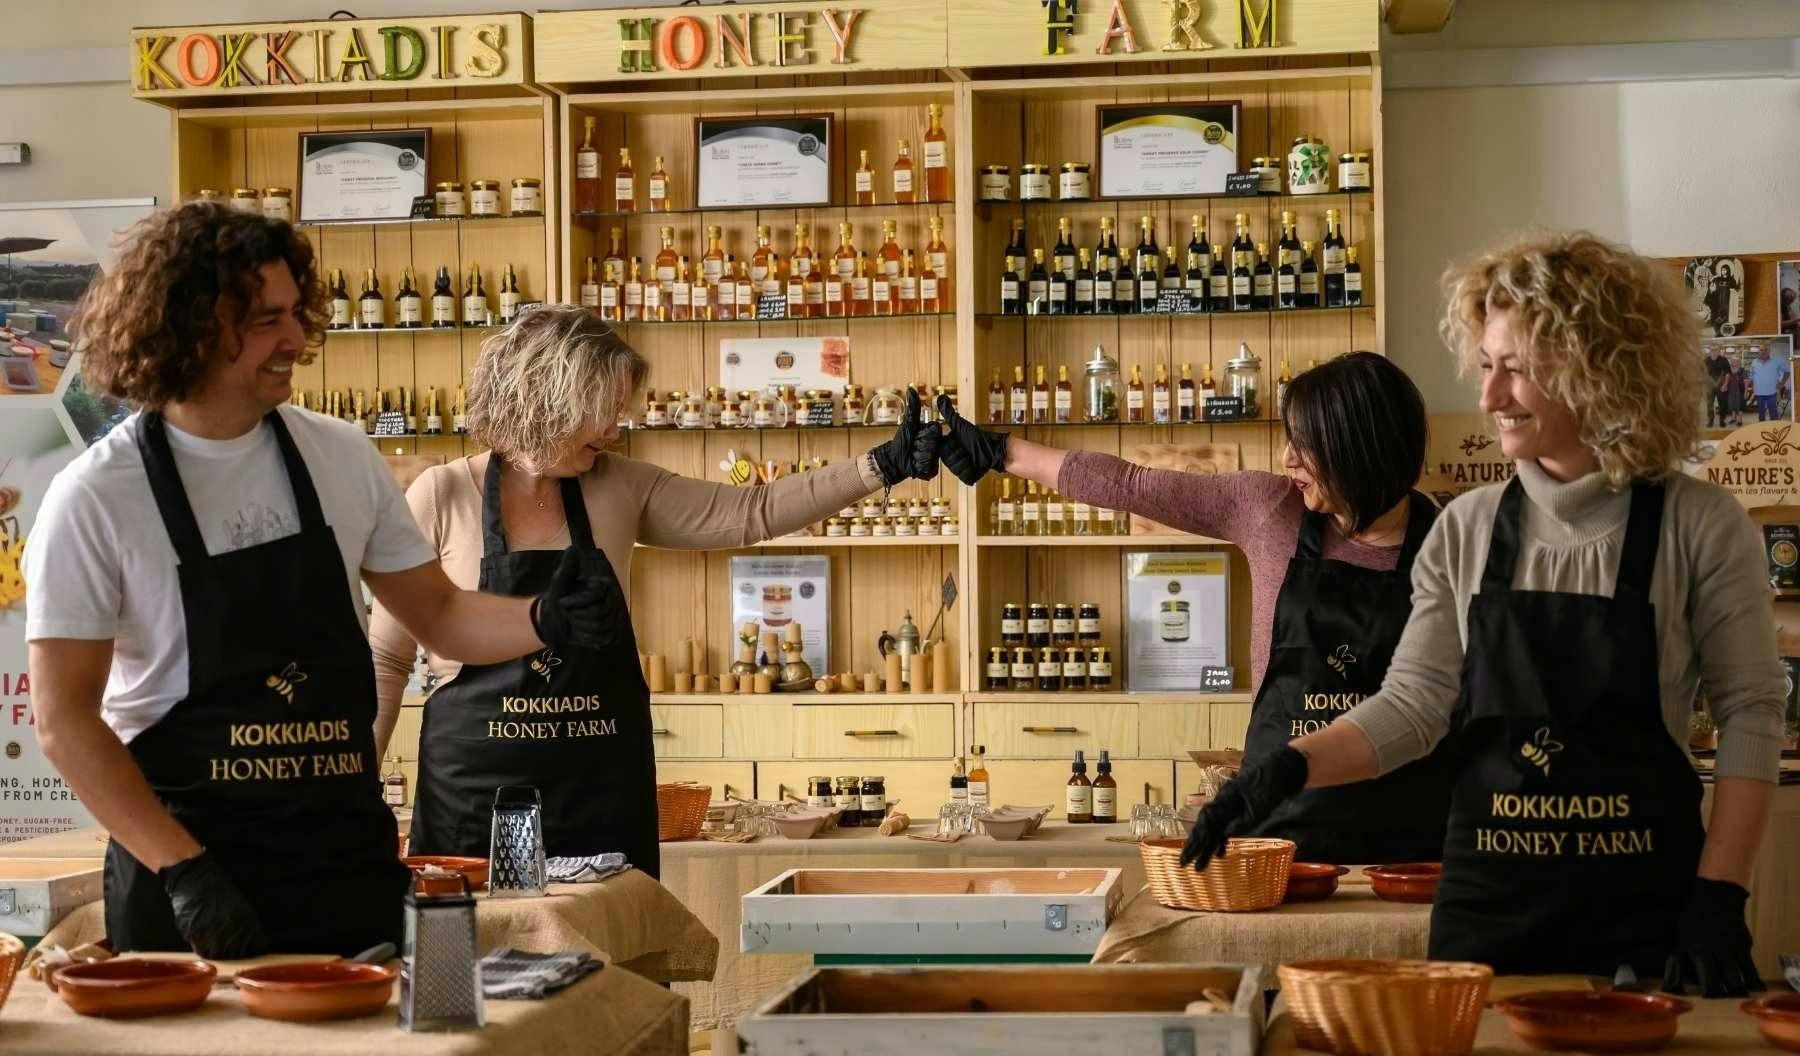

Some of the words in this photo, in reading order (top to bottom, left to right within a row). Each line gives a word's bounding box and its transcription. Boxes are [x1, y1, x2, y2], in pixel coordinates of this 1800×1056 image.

[135, 24, 505, 90] KOKKIADIS
[617, 9, 866, 73] HONEY
[1041, 0, 1281, 55] FARM
[1708, 467, 1794, 486] NATURE'S
[502, 695, 600, 713] KOKKIADIS
[1304, 693, 1367, 710] KOKKI
[229, 719, 350, 747] KOKKIADIS
[487, 721, 562, 739] HONEY
[567, 719, 618, 737] FARM
[209, 755, 307, 781] HONEY
[312, 752, 364, 777] FARM
[4, 790, 43, 801] FROM
[1492, 793, 1631, 819] KOKKIADIS
[1476, 828, 1569, 855] HONEY
[1576, 829, 1655, 855] FARM
